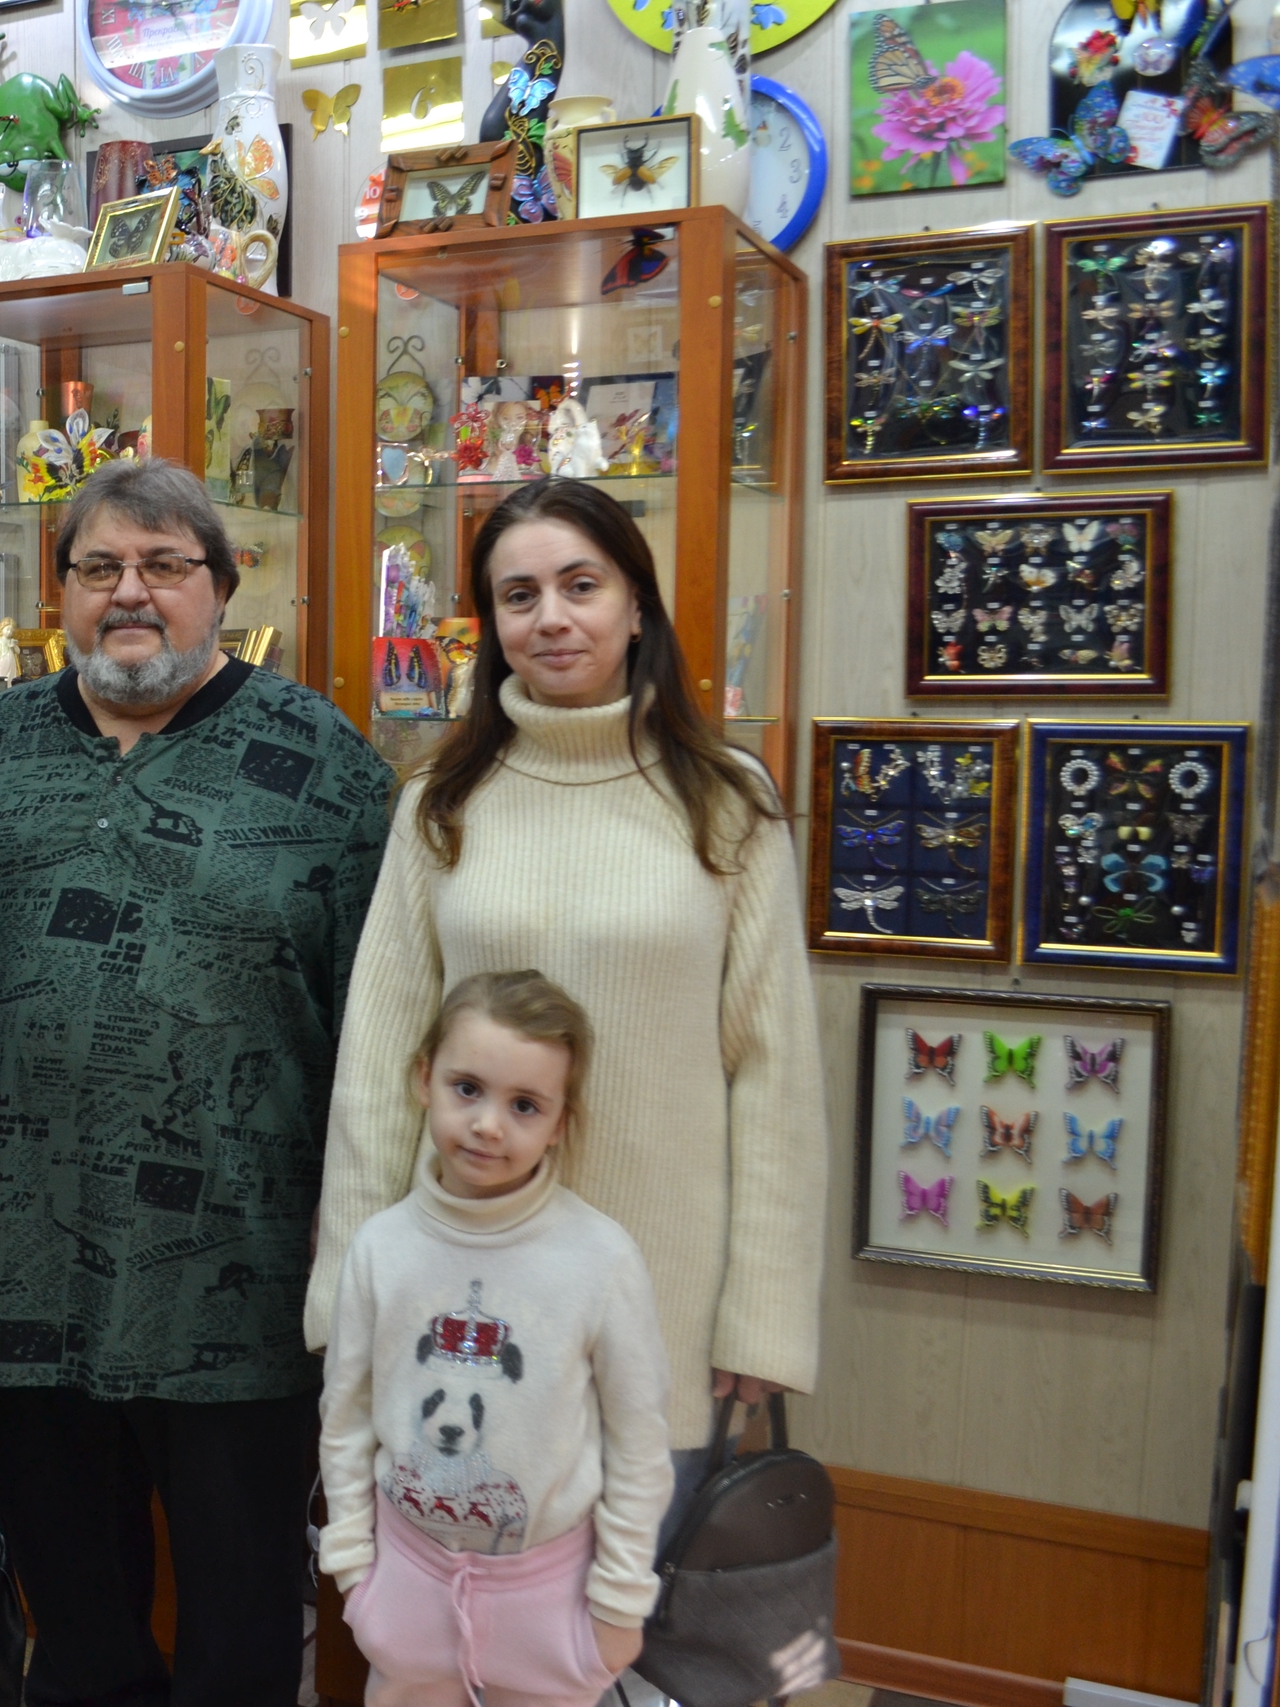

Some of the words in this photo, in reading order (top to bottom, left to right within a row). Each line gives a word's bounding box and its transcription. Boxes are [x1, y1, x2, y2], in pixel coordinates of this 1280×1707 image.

[160, 67, 174, 83] VI
[410, 86, 436, 120] 6
[779, 126, 792, 152] 2
[789, 158, 802, 184] 3
[365, 186, 380, 199] 10
[358, 207, 369, 220] 9
[776, 193, 789, 219] 4
